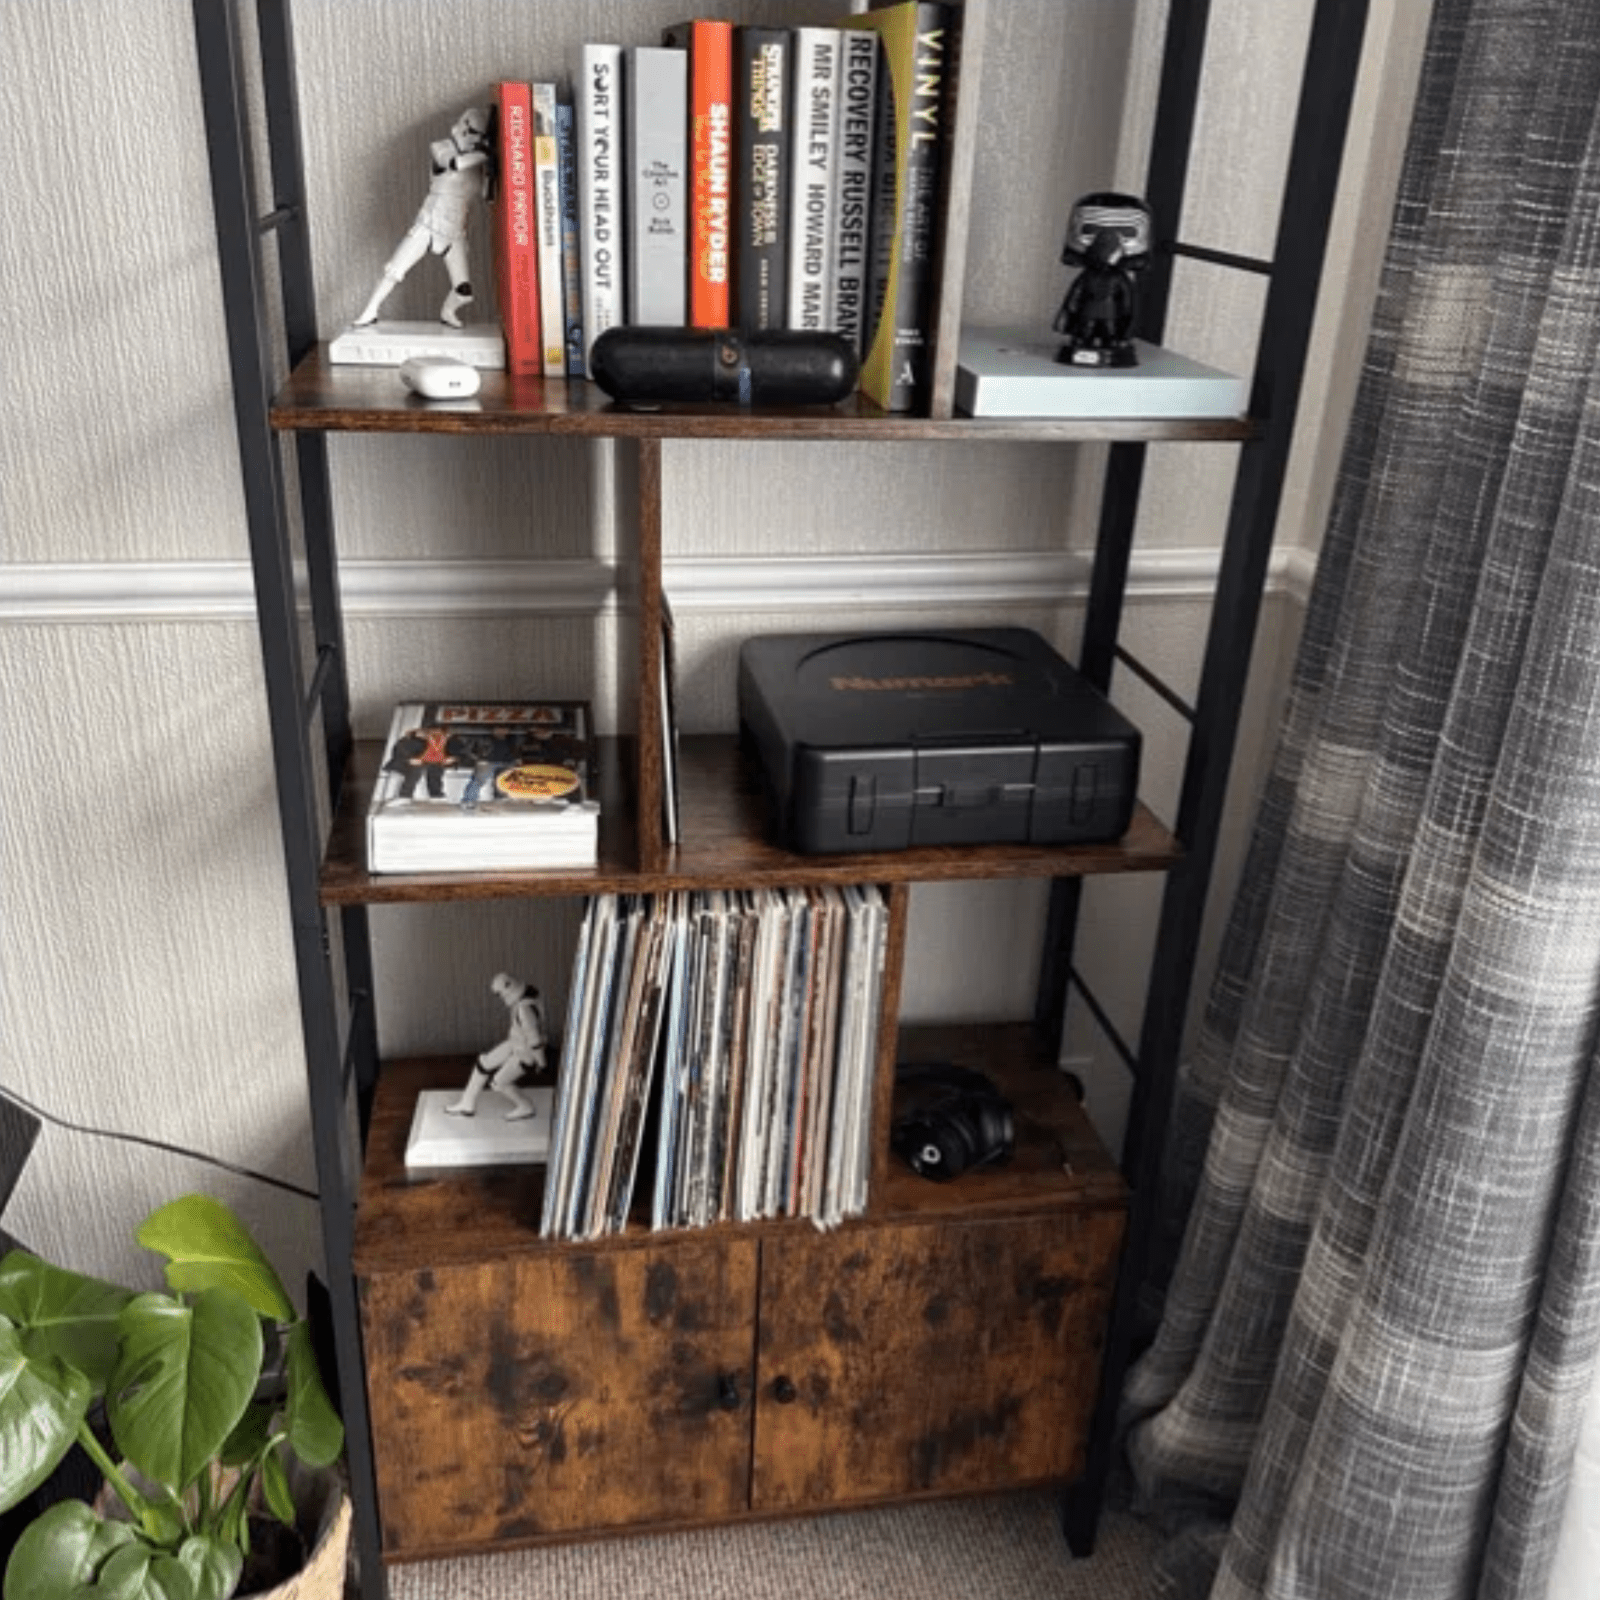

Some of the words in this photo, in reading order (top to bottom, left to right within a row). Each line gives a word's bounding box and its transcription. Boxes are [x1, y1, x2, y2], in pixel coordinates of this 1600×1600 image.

[592, 62, 611, 119] SORT
[750, 59, 766, 118] THINGS
[759, 44, 783, 133] STRANGER
[813, 43, 833, 79] MR
[843, 36, 872, 162] RECOVERY
[912, 29, 944, 150] VINYL
[592, 126, 611, 182] YOUR
[709, 102, 729, 193] SHAUN
[807, 85, 832, 170] SMILEY
[594, 187, 612, 243] HEAD
[764, 143, 779, 229] DARKNESS
[839, 168, 868, 269] RUSSELL
[594, 249, 613, 290] OUT
[709, 197, 729, 283] RYDER
[804, 183, 826, 275] HOWARD
[801, 281, 821, 329] MAR
[443, 705, 557, 721] PIZZA
